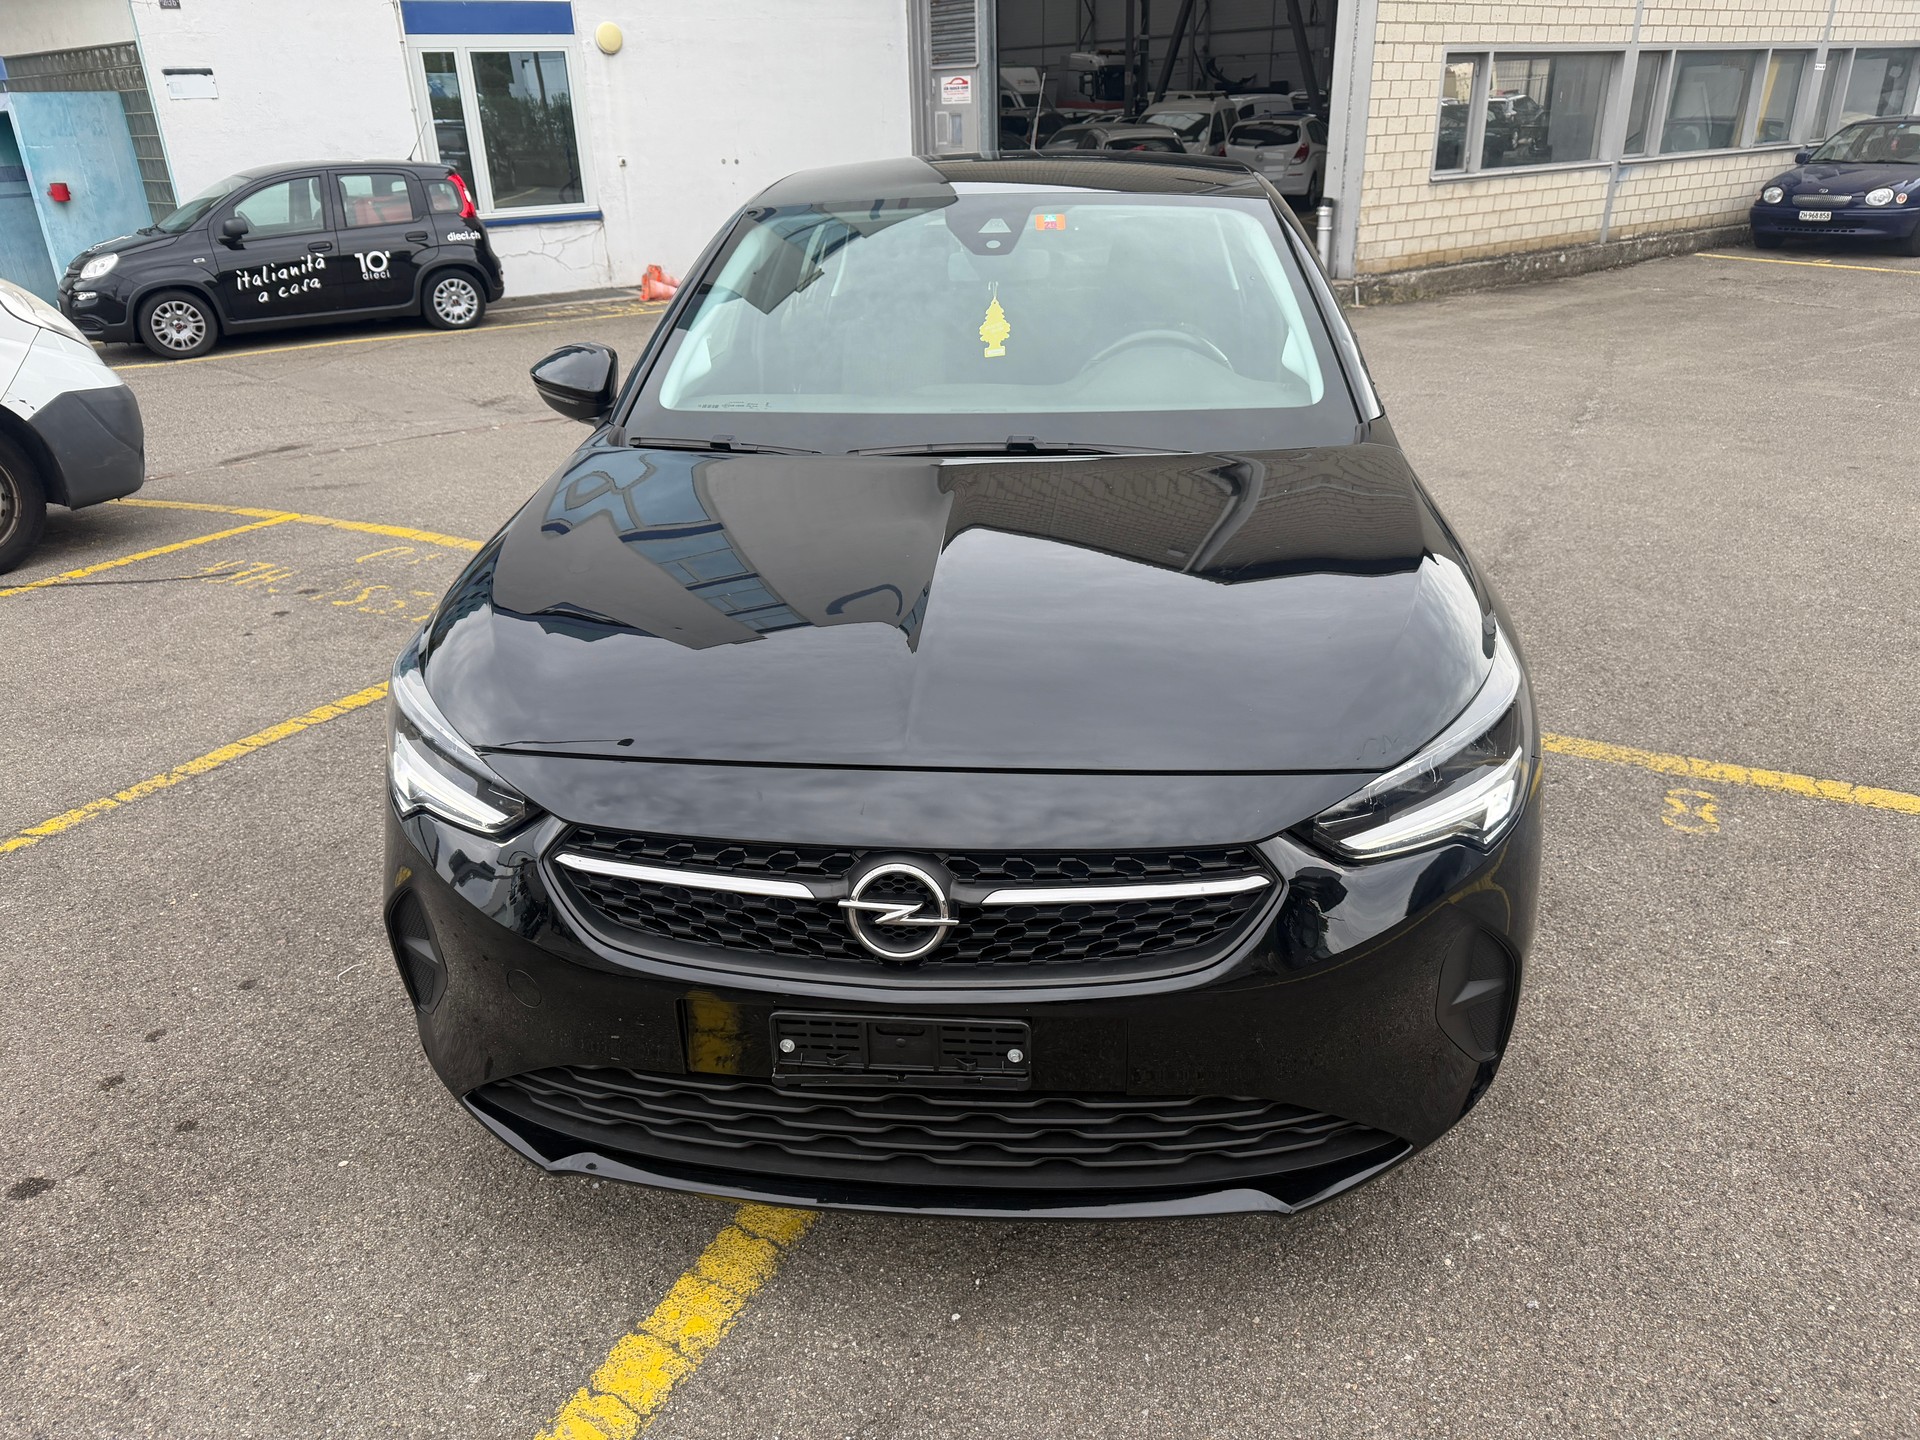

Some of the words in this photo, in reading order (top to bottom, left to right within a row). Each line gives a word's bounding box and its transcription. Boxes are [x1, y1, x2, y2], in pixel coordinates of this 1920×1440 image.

[447, 231, 481, 241] dieci.ch
[362, 271, 391, 281] dieci
[257, 291, 270, 303] a
[278, 277, 323, 299] casa
